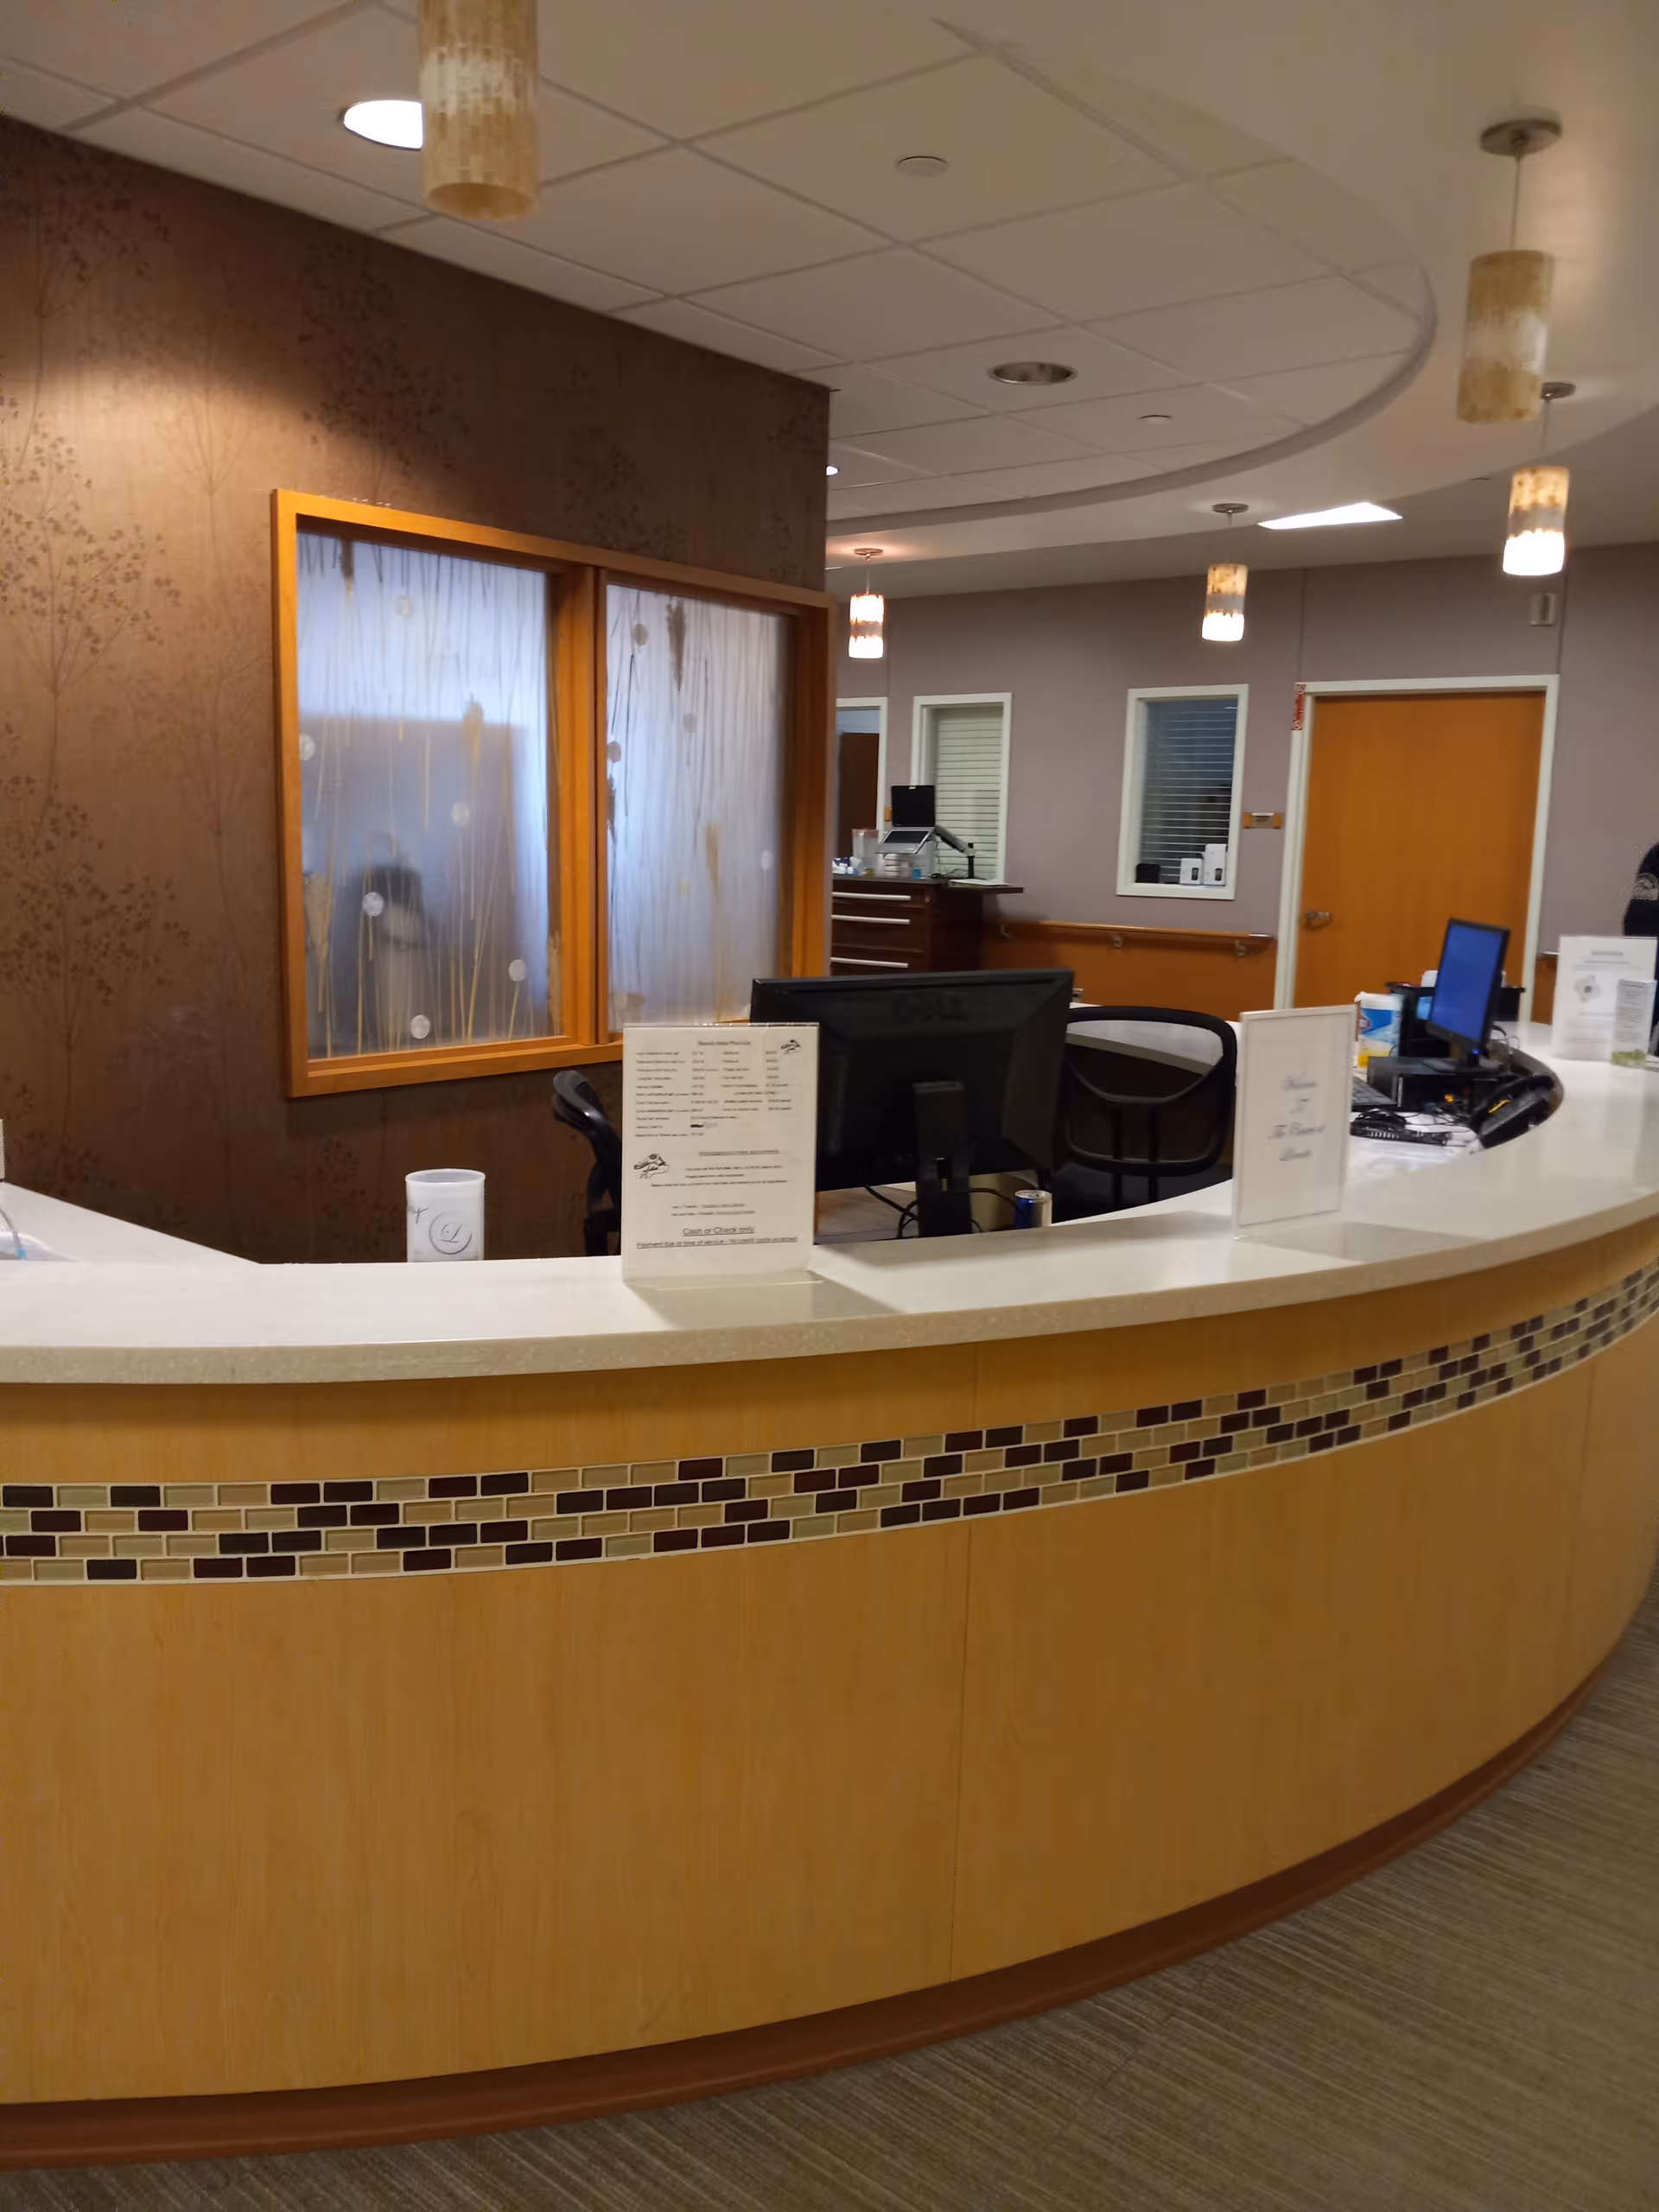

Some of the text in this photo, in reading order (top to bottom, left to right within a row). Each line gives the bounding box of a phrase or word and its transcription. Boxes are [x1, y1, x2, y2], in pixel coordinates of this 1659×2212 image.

[683, 1227, 702, 1236] Cash
[714, 1226, 736, 1235] Check
[739, 1225, 754, 1234] only
